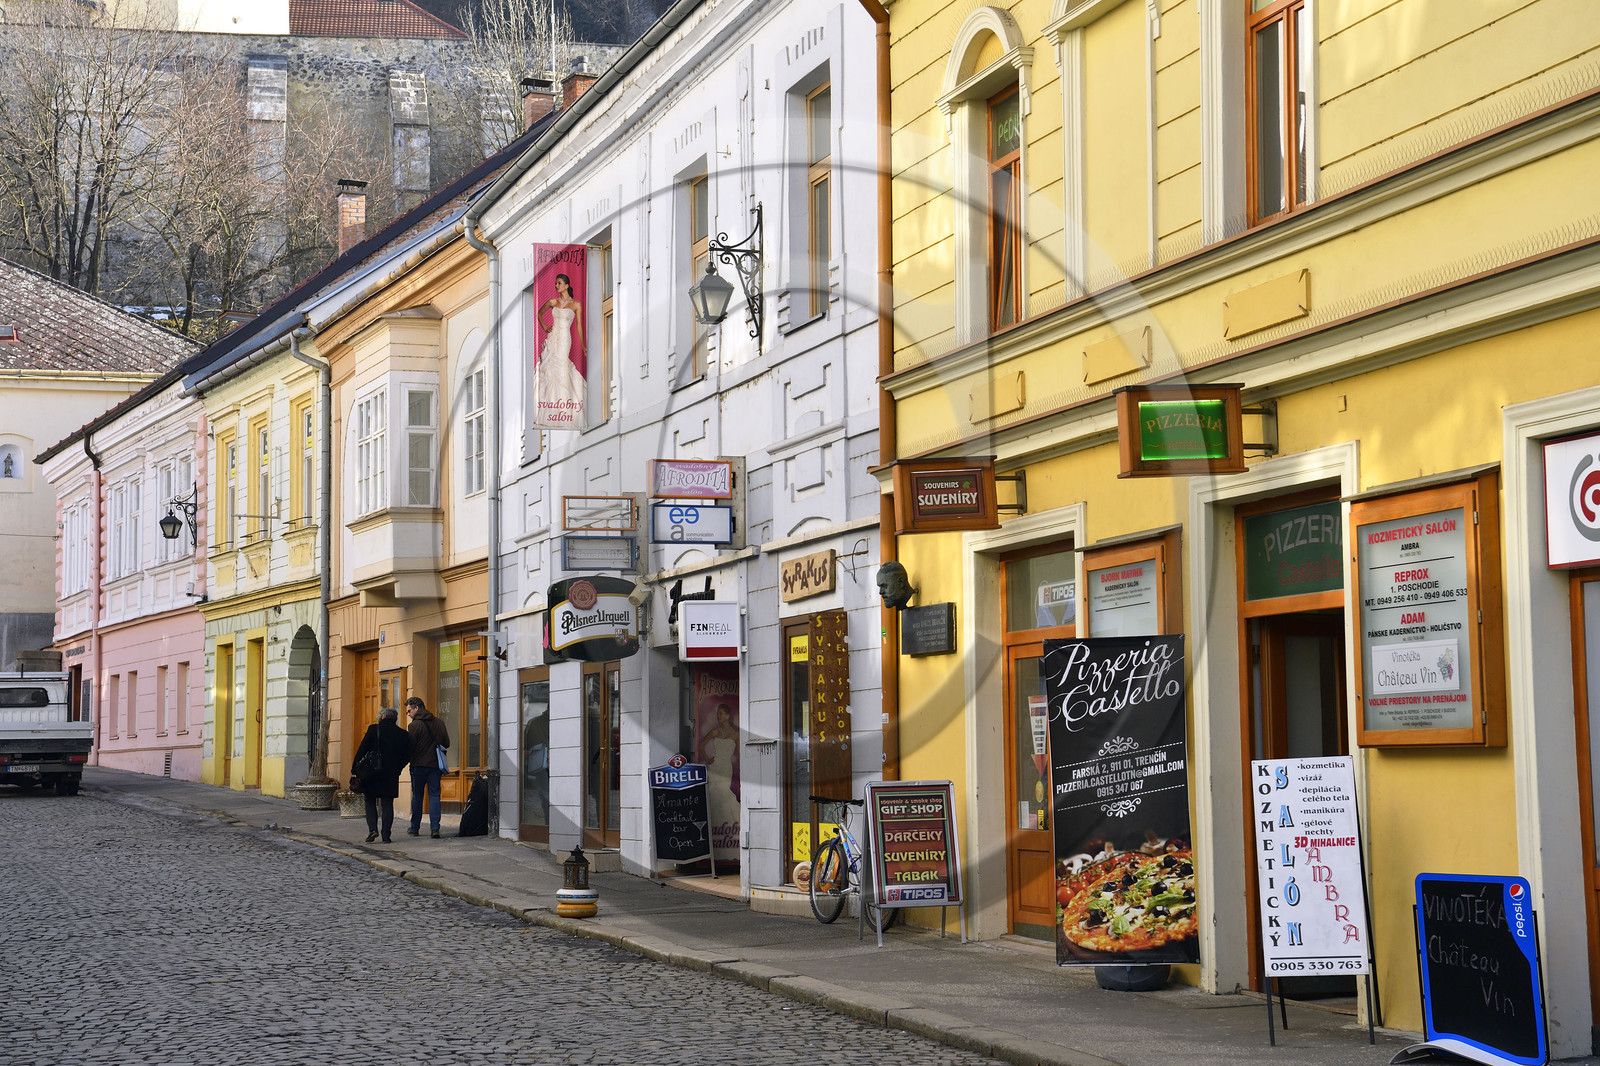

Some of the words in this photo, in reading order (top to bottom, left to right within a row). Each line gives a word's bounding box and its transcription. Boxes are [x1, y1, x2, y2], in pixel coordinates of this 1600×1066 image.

[535, 248, 585, 266] AFRODITA
[537, 398, 584, 413] svadobný
[547, 411, 573, 422] salón
[1146, 413, 1223, 434] PIZZERIA
[1160, 440, 1212, 451] CASTELLO
[656, 465, 728, 493] AFRODITA
[924, 481, 959, 490] SOUVENIRS
[917, 490, 978, 506] SUVENÍRY
[1264, 514, 1342, 563] PIZZERI
[1368, 522, 1424, 545] KOZMETICKÝ
[1425, 518, 1456, 535] SALÓN
[1400, 542, 1420, 551] AMBRA
[783, 558, 828, 594] SYRAKUS
[1120, 567, 1143, 580] MATRIX
[1278, 555, 1341, 586] Castello
[1394, 568, 1429, 583] REPROX
[1052, 584, 1075, 600] TIPOS
[1397, 580, 1440, 592] POSCHODIE
[1365, 598, 1376, 607] MT.
[1376, 596, 1392, 605] 0949
[1393, 595, 1405, 603] 256
[1406, 593, 1419, 602] 410
[1424, 591, 1440, 600] 0949
[1441, 589, 1454, 598] 406
[1455, 588, 1468, 597] 533
[561, 610, 597, 635] Pilsner
[597, 609, 630, 627] Urquell
[1400, 612, 1425, 625] ADAM
[1368, 628, 1388, 638] PÁNSKE
[1389, 625, 1426, 636] KADERNÍCTVO
[1430, 621, 1462, 632] HOLIČSTVO
[1047, 640, 1174, 695] Pizzeria
[816, 615, 826, 743] SYRAKUS
[1378, 669, 1417, 687] Château
[1420, 666, 1437, 683] Vin
[1050, 660, 1181, 731] Castello
[1388, 696, 1422, 705] PRIESTORY
[1422, 696, 1432, 704] NA
[1432, 693, 1467, 703] PRENÁJOM
[837, 677, 845, 742] SYROV
[1072, 763, 1100, 779] FARSKÁ
[1101, 764, 1109, 774] 2,
[1110, 761, 1122, 771] 911
[1123, 759, 1134, 769] 01,
[1135, 750, 1167, 767] TRENČÍN
[1300, 761, 1346, 769] kozmetika
[655, 770, 703, 784] BIRELL
[1056, 760, 1184, 794] PIZZERIA.CASTELLOTN@GMAIL.COM
[1096, 787, 1114, 798] 0915
[1115, 783, 1129, 794] 347
[1130, 779, 1144, 791] 067
[1302, 785, 1341, 794] depilácia
[1302, 795, 1331, 803] celého
[880, 805, 907, 815] GIFT
[911, 804, 943, 814] SHOP
[1303, 806, 1345, 814] manikúra
[1304, 819, 1333, 828] gélové
[884, 829, 943, 842] DARČEKY
[1304, 828, 1334, 836] nechty
[669, 836, 694, 851] Open
[1294, 836, 1309, 848] 3D
[1310, 836, 1356, 848] MIHALNICE
[884, 848, 946, 862] SUVENÍRY
[1257, 765, 1281, 947] KOZMETICKÝ
[1275, 765, 1303, 946] SALÓN
[894, 870, 939, 882] TABAK
[903, 889, 943, 899] TIPOS
[1304, 846, 1360, 945] AMBRA
[1423, 885, 1508, 928] VINOTÉKA
[1513, 901, 1527, 937] pepsi
[1428, 934, 1499, 975] Château
[1271, 961, 1305, 971] 0905
[1308, 961, 1334, 970] 330
[1337, 960, 1363, 970] 763
[1480, 976, 1515, 1016] Vin
